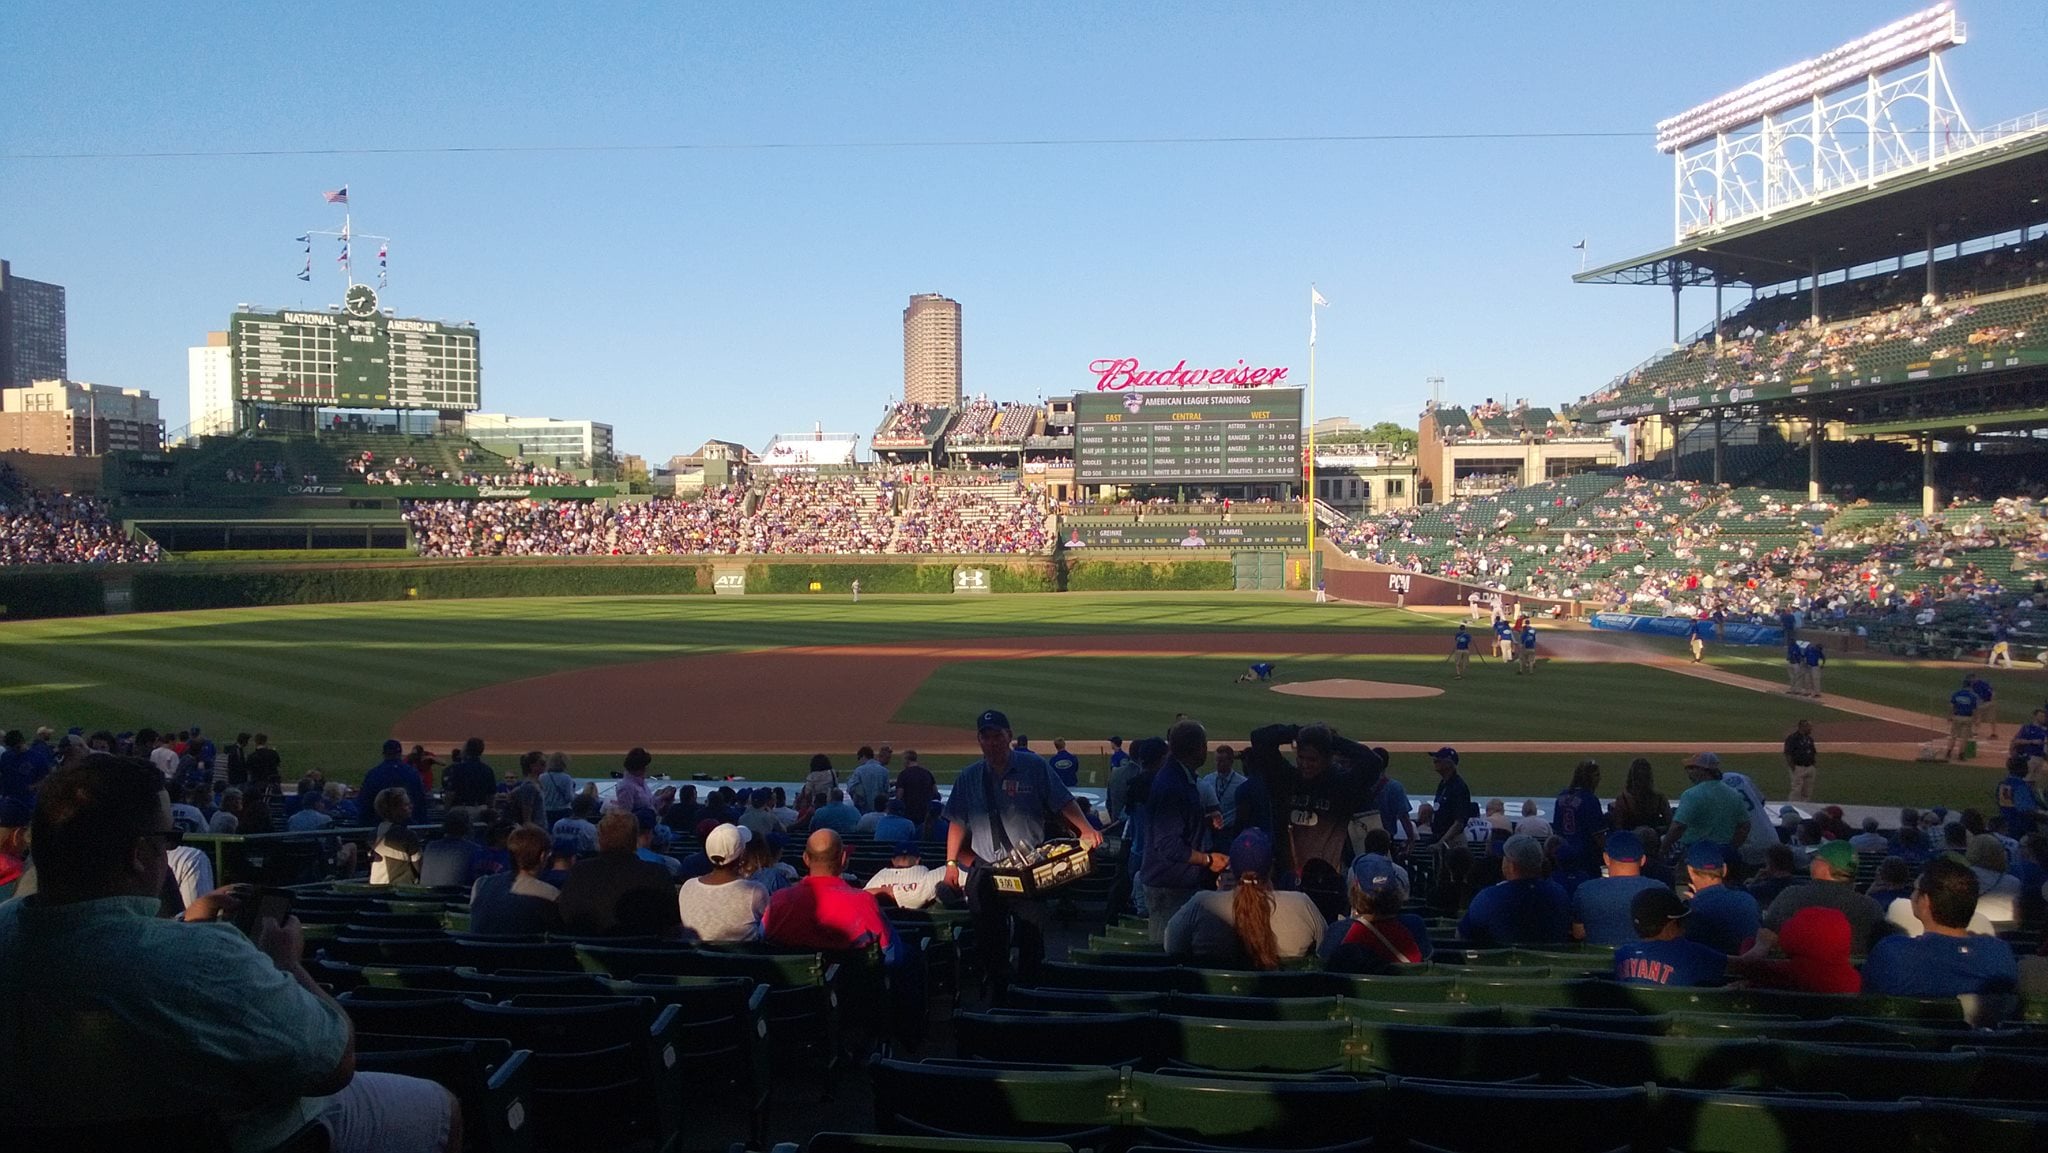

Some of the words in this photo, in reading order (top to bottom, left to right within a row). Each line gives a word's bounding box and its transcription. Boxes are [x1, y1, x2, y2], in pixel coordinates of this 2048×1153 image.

[284, 312, 337, 325] NATIONAL
[387, 320, 436, 332] AMERICAN
[1089, 357, 1289, 391] Budweiser
[1144, 397, 1182, 406] AMERICAN
[1183, 396, 1209, 406] LEAGUE
[1210, 395, 1250, 404] STANDINGS
[1676, 396, 1699, 406] DODGERS
[1740, 389, 1754, 398] CUBS
[1172, 412, 1201, 420] CENTRAL
[1251, 411, 1270, 419] WEST
[478, 486, 531, 497] Budweiser
[715, 576, 743, 584] ATI
[984, 712, 992, 720] C
[1469, 828, 1488, 840] 17
